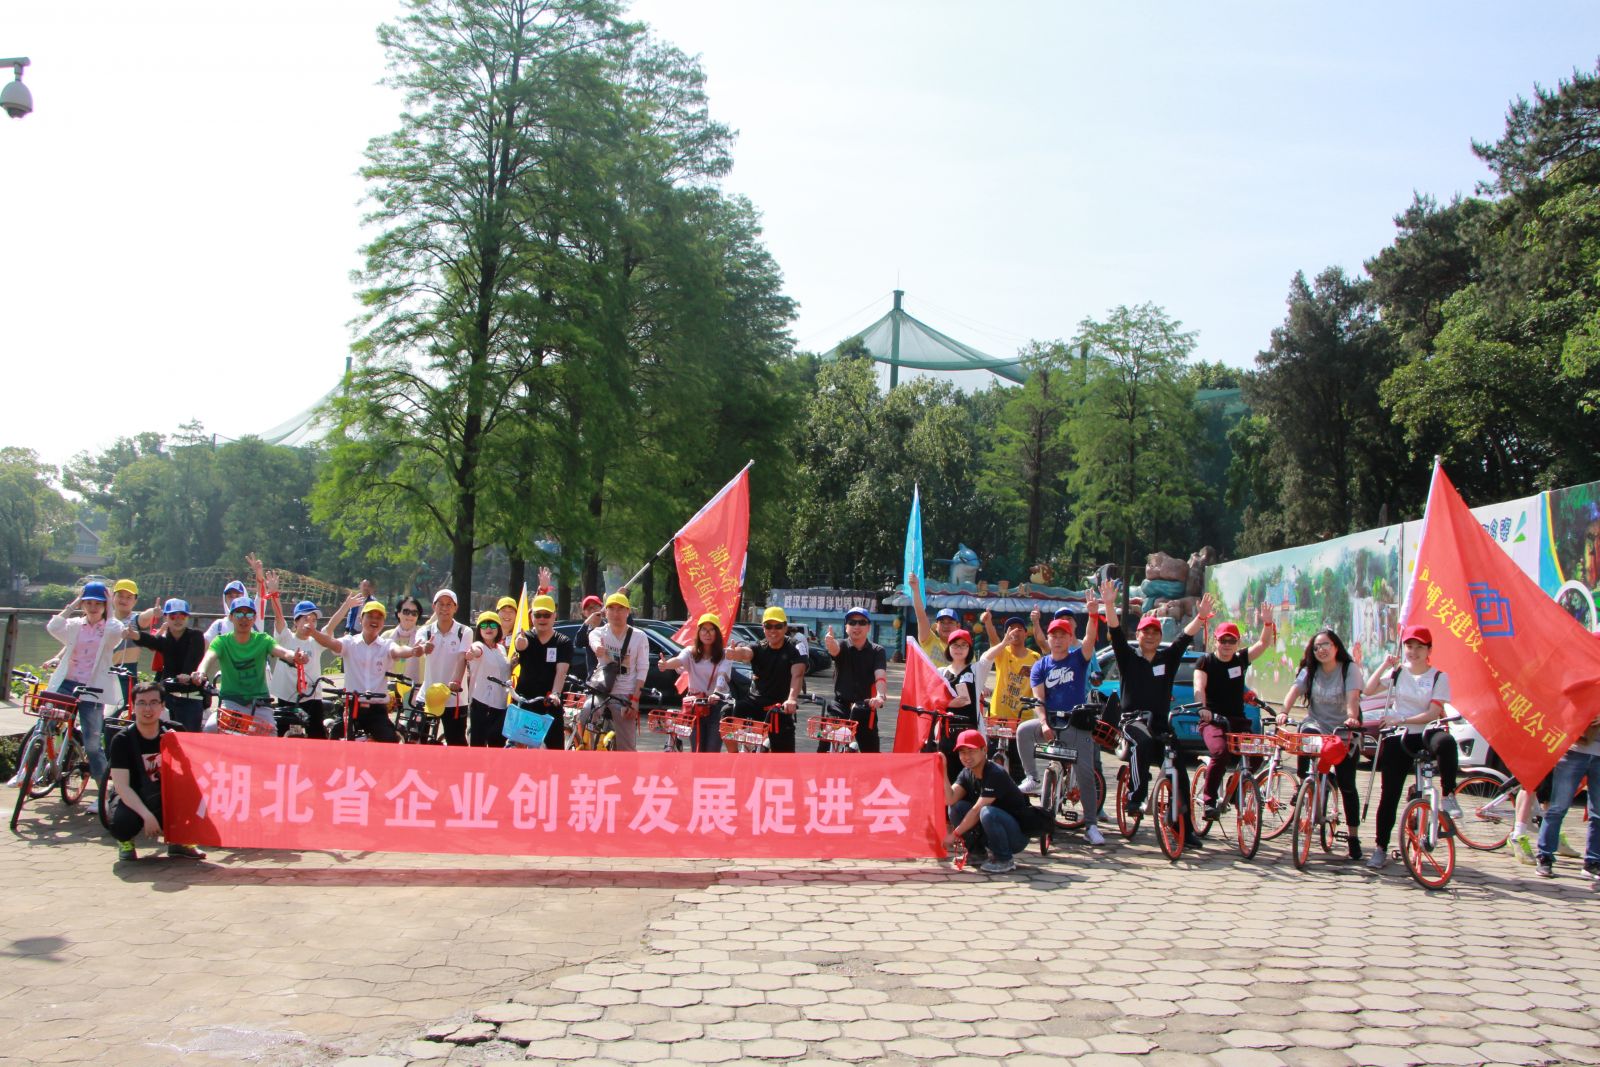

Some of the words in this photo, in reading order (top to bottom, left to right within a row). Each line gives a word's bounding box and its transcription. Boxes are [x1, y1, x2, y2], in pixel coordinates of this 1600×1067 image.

[1058, 671, 1075, 685] AIR
[197, 760, 911, 835] 湖北省企业创新发展促进会
